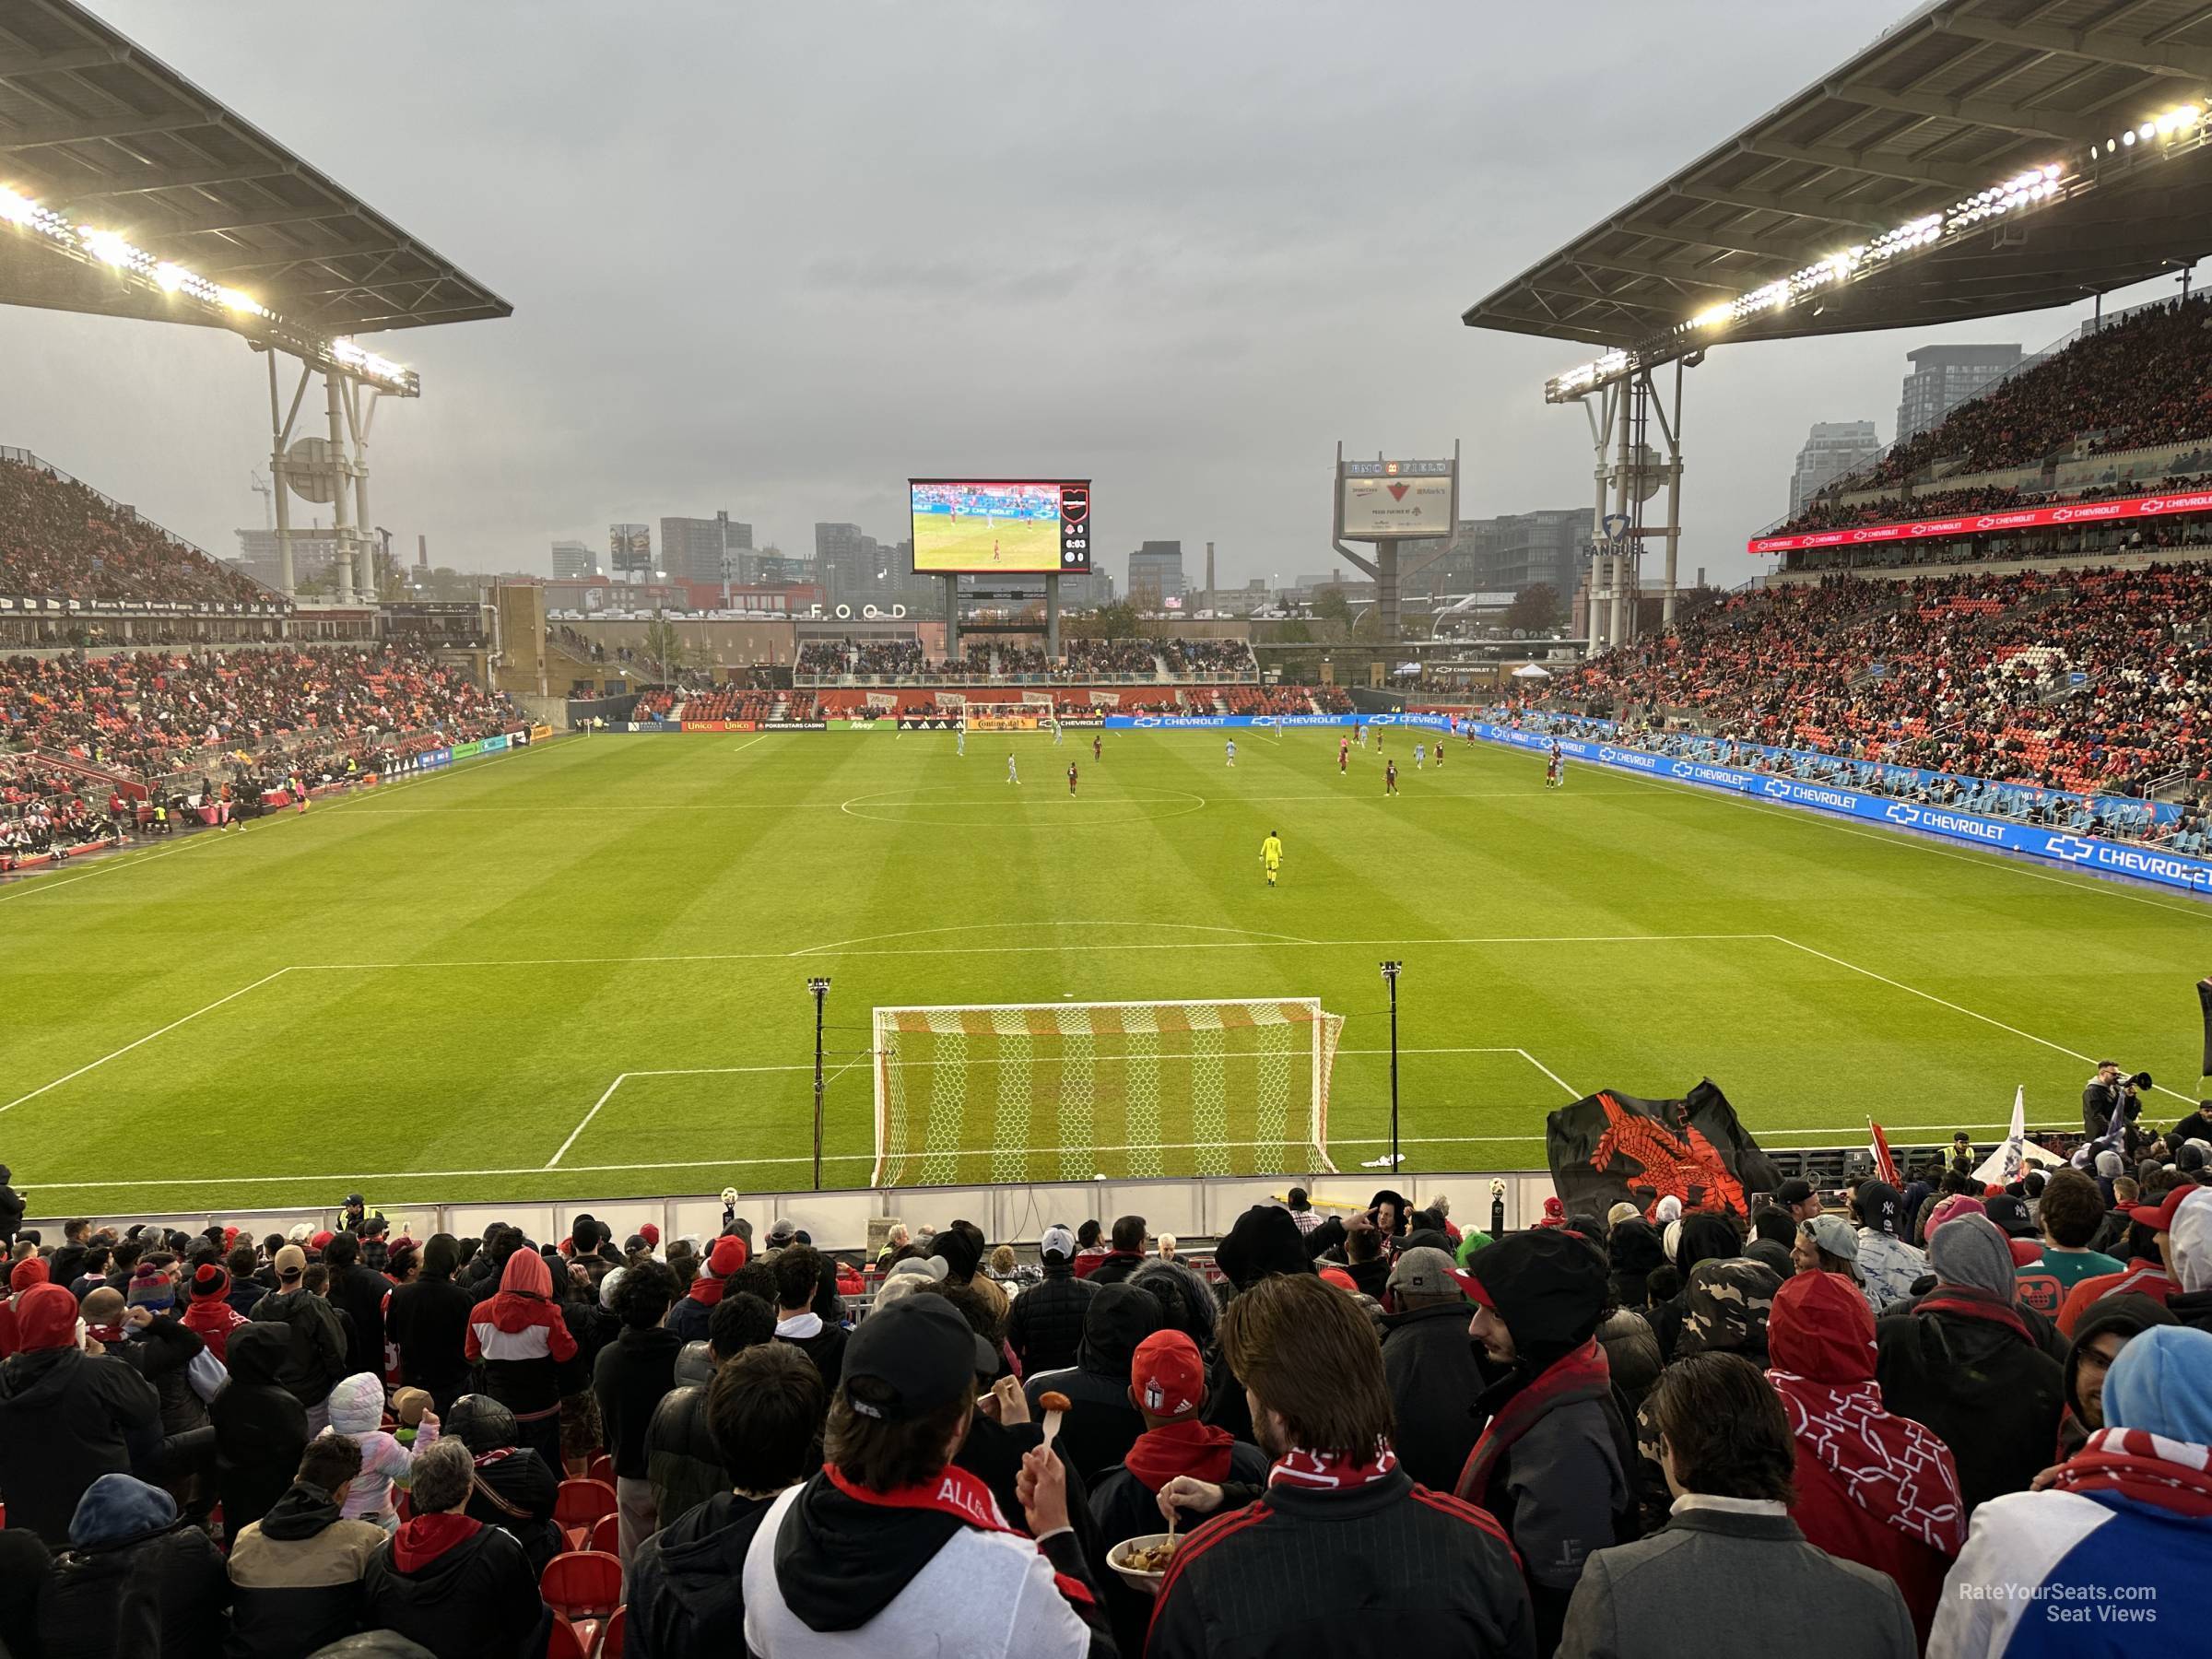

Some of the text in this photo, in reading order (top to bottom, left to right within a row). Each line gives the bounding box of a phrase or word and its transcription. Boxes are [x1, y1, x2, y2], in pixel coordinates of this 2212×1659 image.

[1403, 463, 1446, 473] FIELD
[2074, 506, 2121, 518] CHEVROLET
[1995, 513, 2036, 525] CHEVROLET
[1867, 528, 1899, 538] CHEVROLET
[1927, 522, 1962, 533] CHEVROLET
[811, 604, 906, 619] FOOD
[688, 722, 712, 730] Unico
[724, 721, 749, 730] Unico
[1282, 716, 1342, 724] CHEVROLET
[1617, 752, 1656, 768] CHEVROLET
[1694, 766, 1744, 786] CHEVROLET
[1793, 786, 1858, 810] CHEVROLET
[1923, 812, 2006, 841] CHEVROLET
